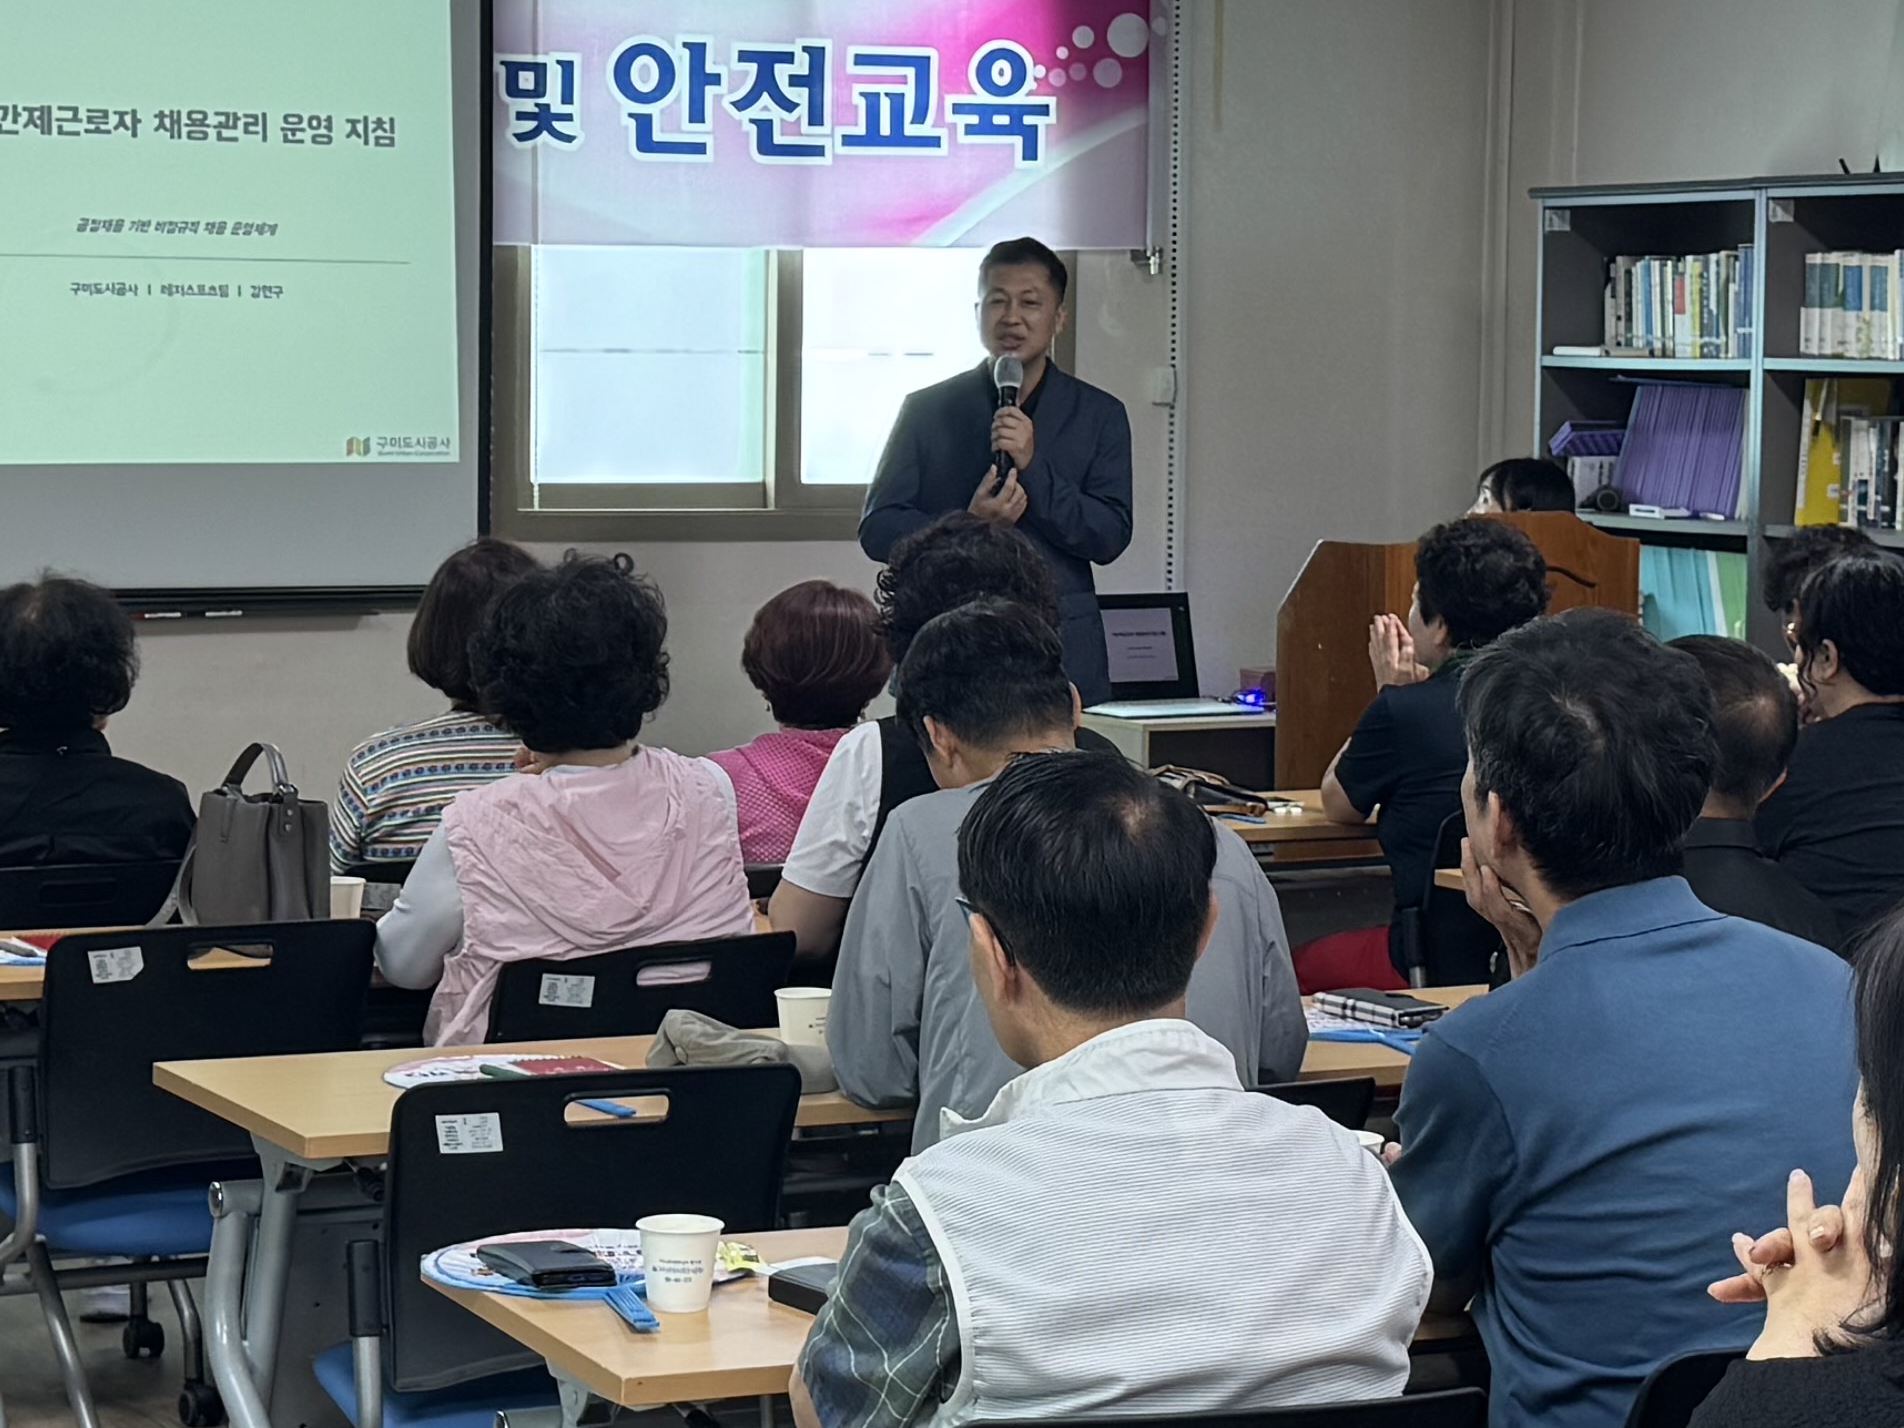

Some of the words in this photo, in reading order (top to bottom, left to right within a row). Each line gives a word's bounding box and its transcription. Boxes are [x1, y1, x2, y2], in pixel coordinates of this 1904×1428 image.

[499, 58, 578, 145] 및
[612, 40, 1052, 162] 안전교육
[152, 108, 269, 144] 채용관리
[279, 112, 334, 146] 운영
[344, 114, 396, 149] 지침
[69, 281, 139, 297] 구미도시공사
